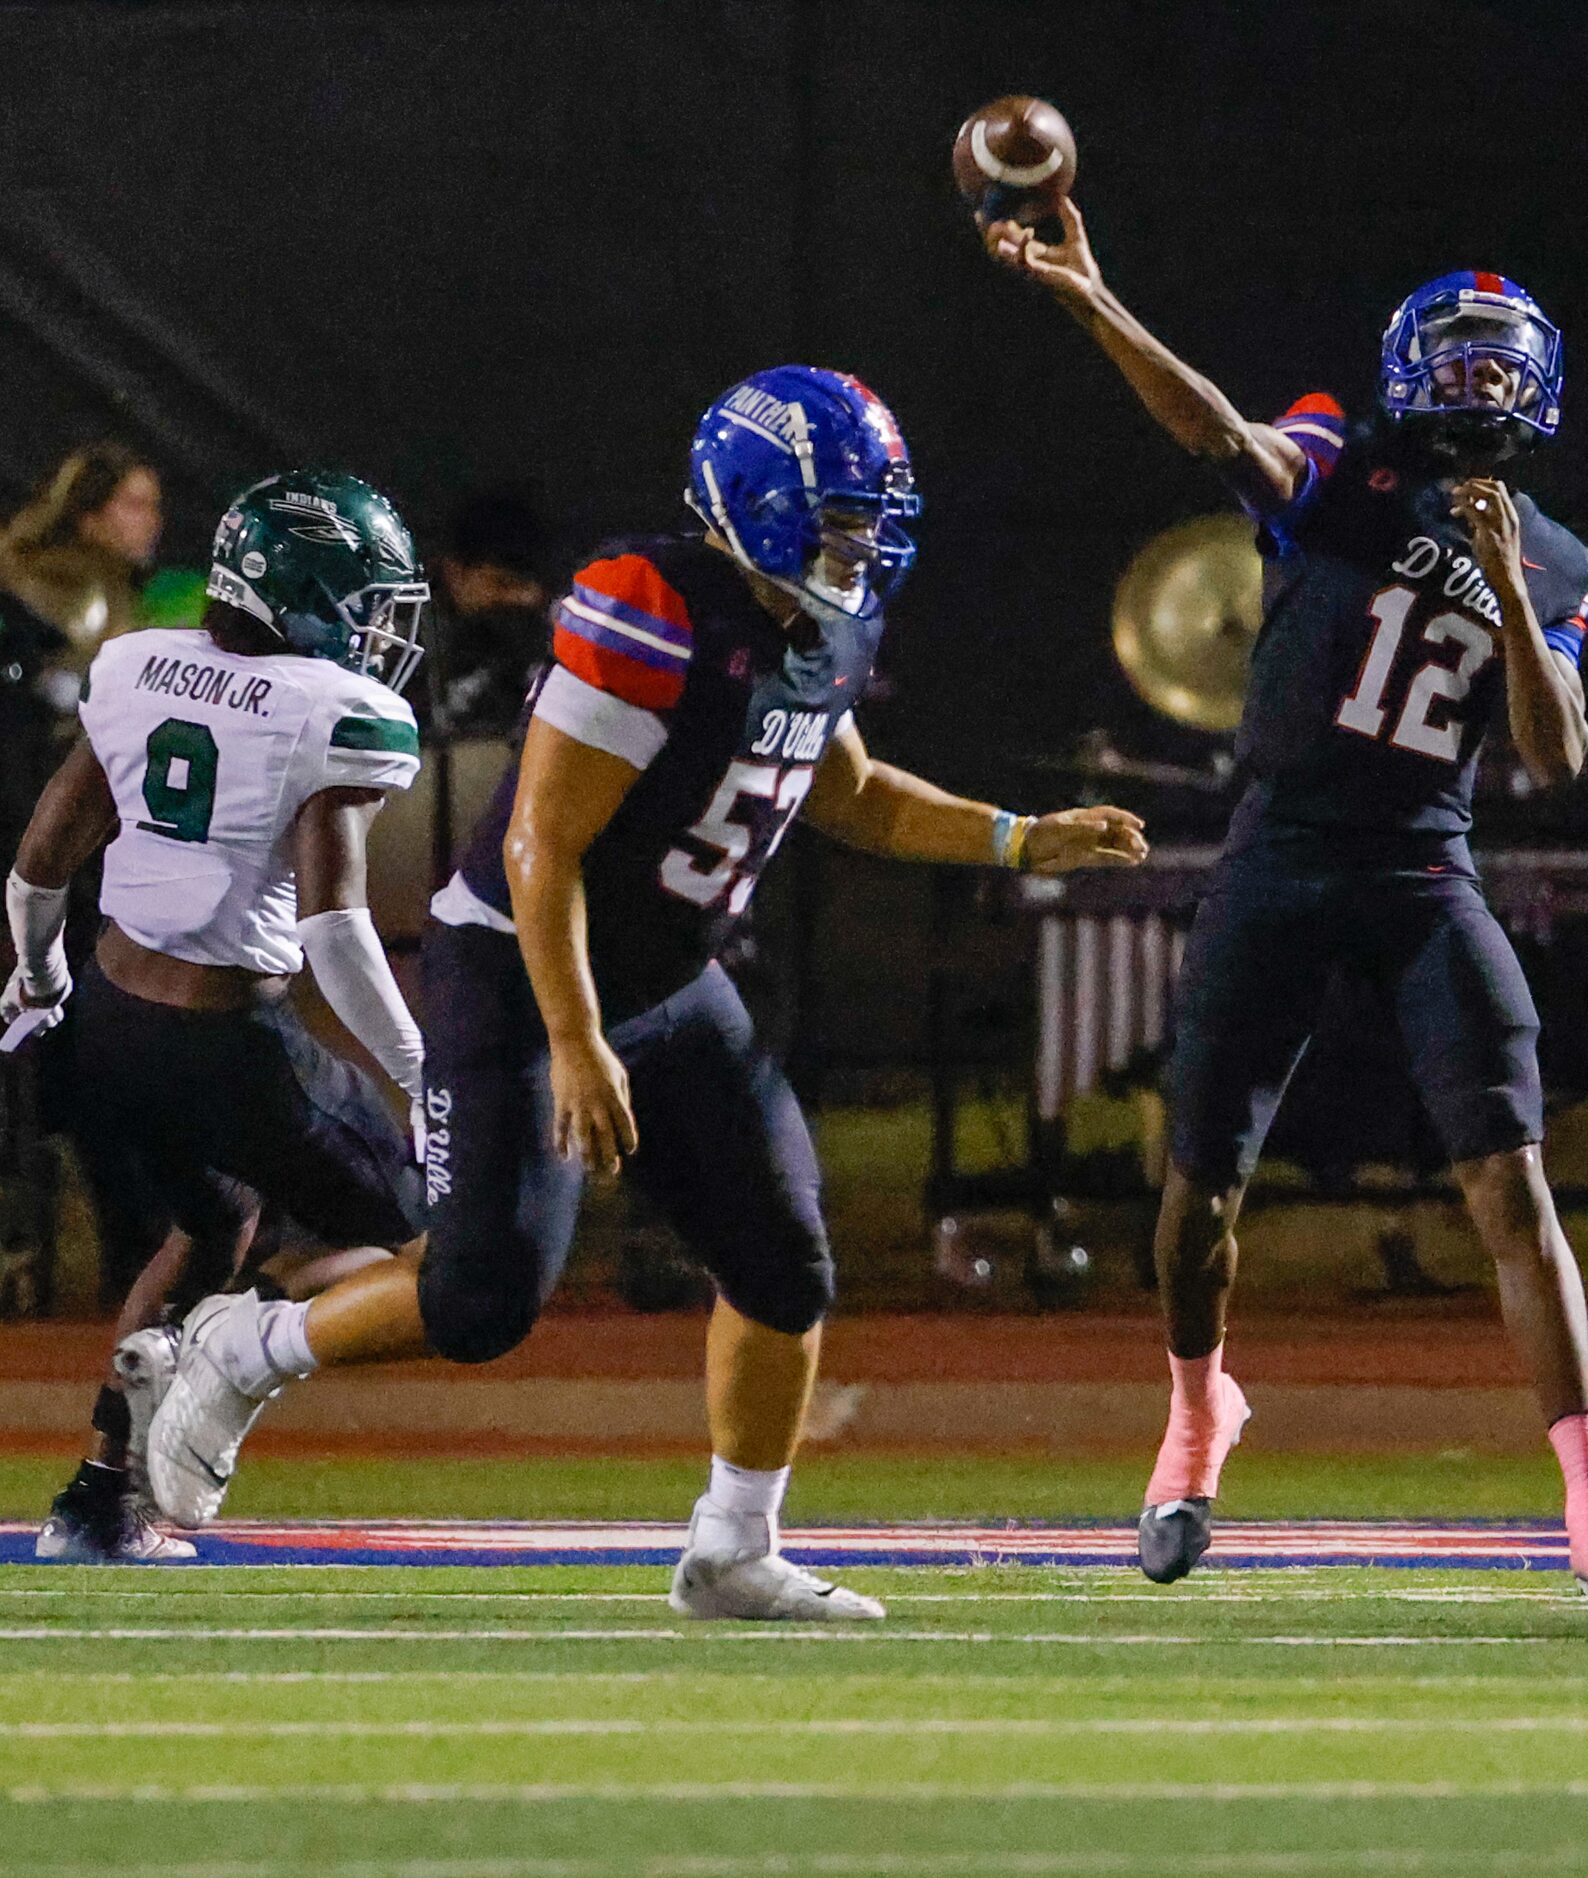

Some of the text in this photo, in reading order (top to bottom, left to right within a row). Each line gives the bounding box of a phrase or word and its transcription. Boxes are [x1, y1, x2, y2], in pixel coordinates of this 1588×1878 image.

[723, 385, 802, 447] PANTHER
[286, 491, 338, 515] INDIANS
[134, 655, 273, 718] MASON JR.
[1334, 582, 1495, 765] 12
[135, 716, 219, 845] 9
